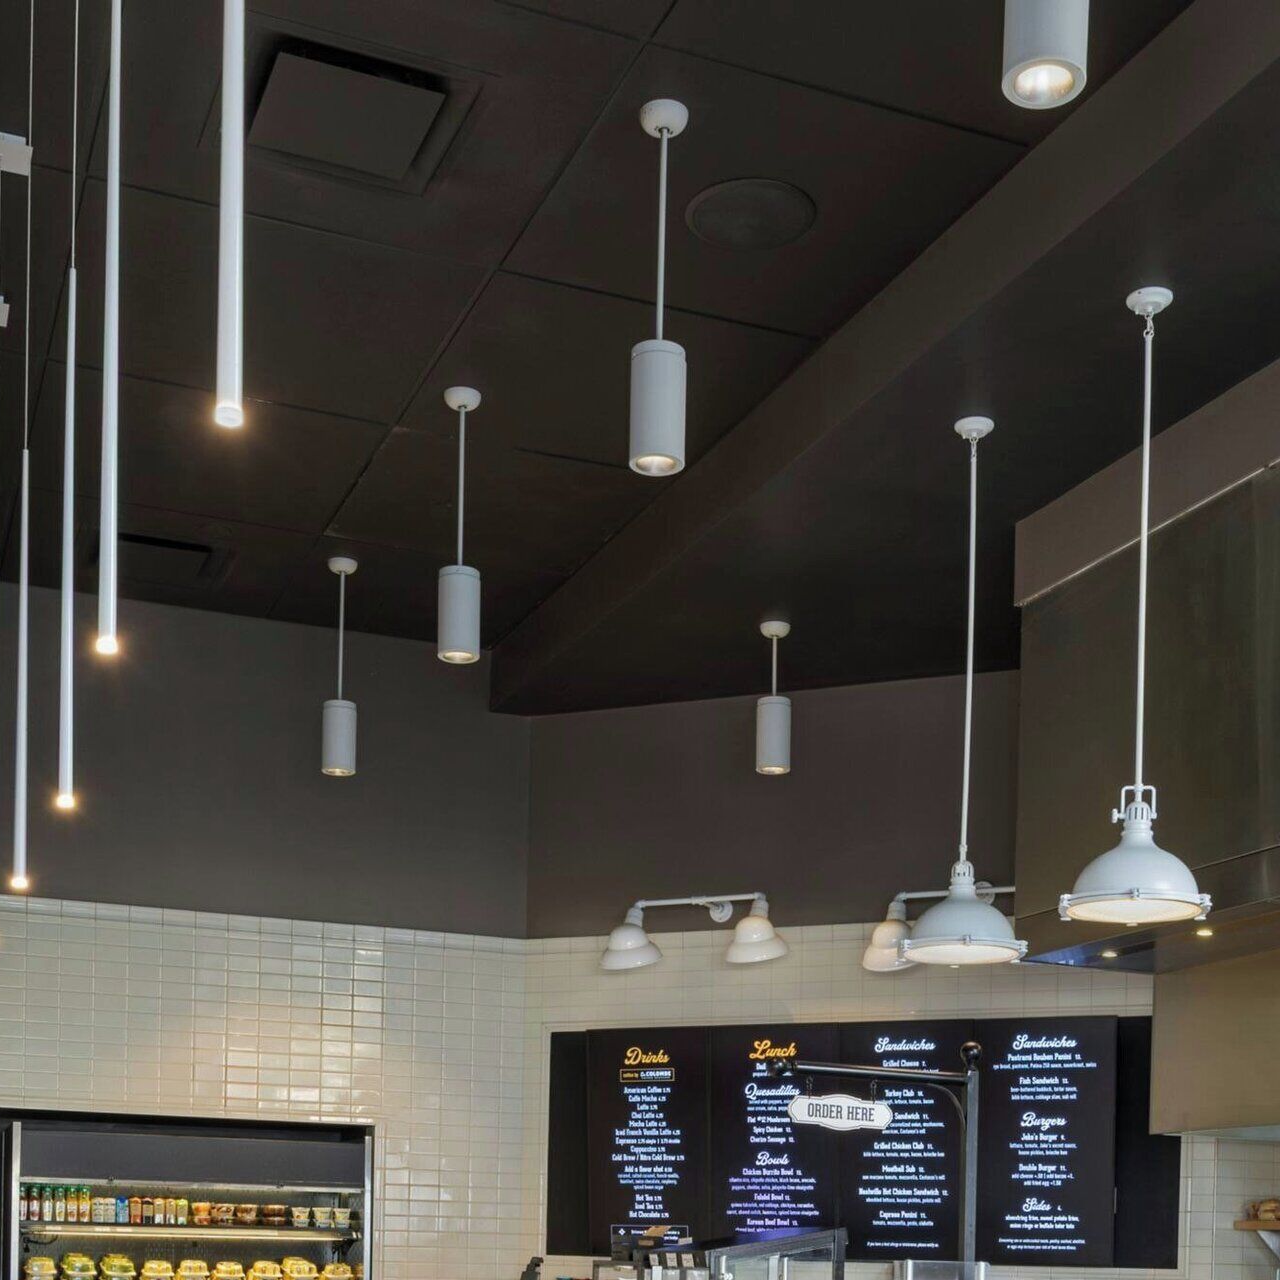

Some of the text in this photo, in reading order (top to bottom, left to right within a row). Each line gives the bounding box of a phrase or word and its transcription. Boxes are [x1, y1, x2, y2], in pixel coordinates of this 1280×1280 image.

[874, 1037, 936, 1053] Sandwiches
[1013, 1034, 1078, 1050] Sandwiches
[749, 1040, 797, 1059] Lunch
[624, 1047, 670, 1065] Drinks
[1033, 1053, 1053, 1061] Reuben
[745, 1083, 800, 1100] Quesadillas
[885, 1089, 915, 1098] Turkey Club
[807, 1103, 842, 1120] ORDER
[847, 1106, 875, 1121] HERE
[894, 1112, 920, 1120] Sandwich
[1020, 1111, 1068, 1131] Burgers
[753, 1126, 765, 1134] Spicy
[615, 1138, 637, 1146] Espresso
[1021, 1133, 1058, 1142] Jake's Burger
[874, 1142, 891, 1150] Grilled
[892, 1142, 911, 1150] Chicken
[912, 1142, 924, 1150] Club
[755, 1151, 789, 1165] Bowls
[1038, 1164, 1056, 1172] Burger
[1022, 1198, 1052, 1212] Sides
[880, 1211, 900, 1220] Caprese
